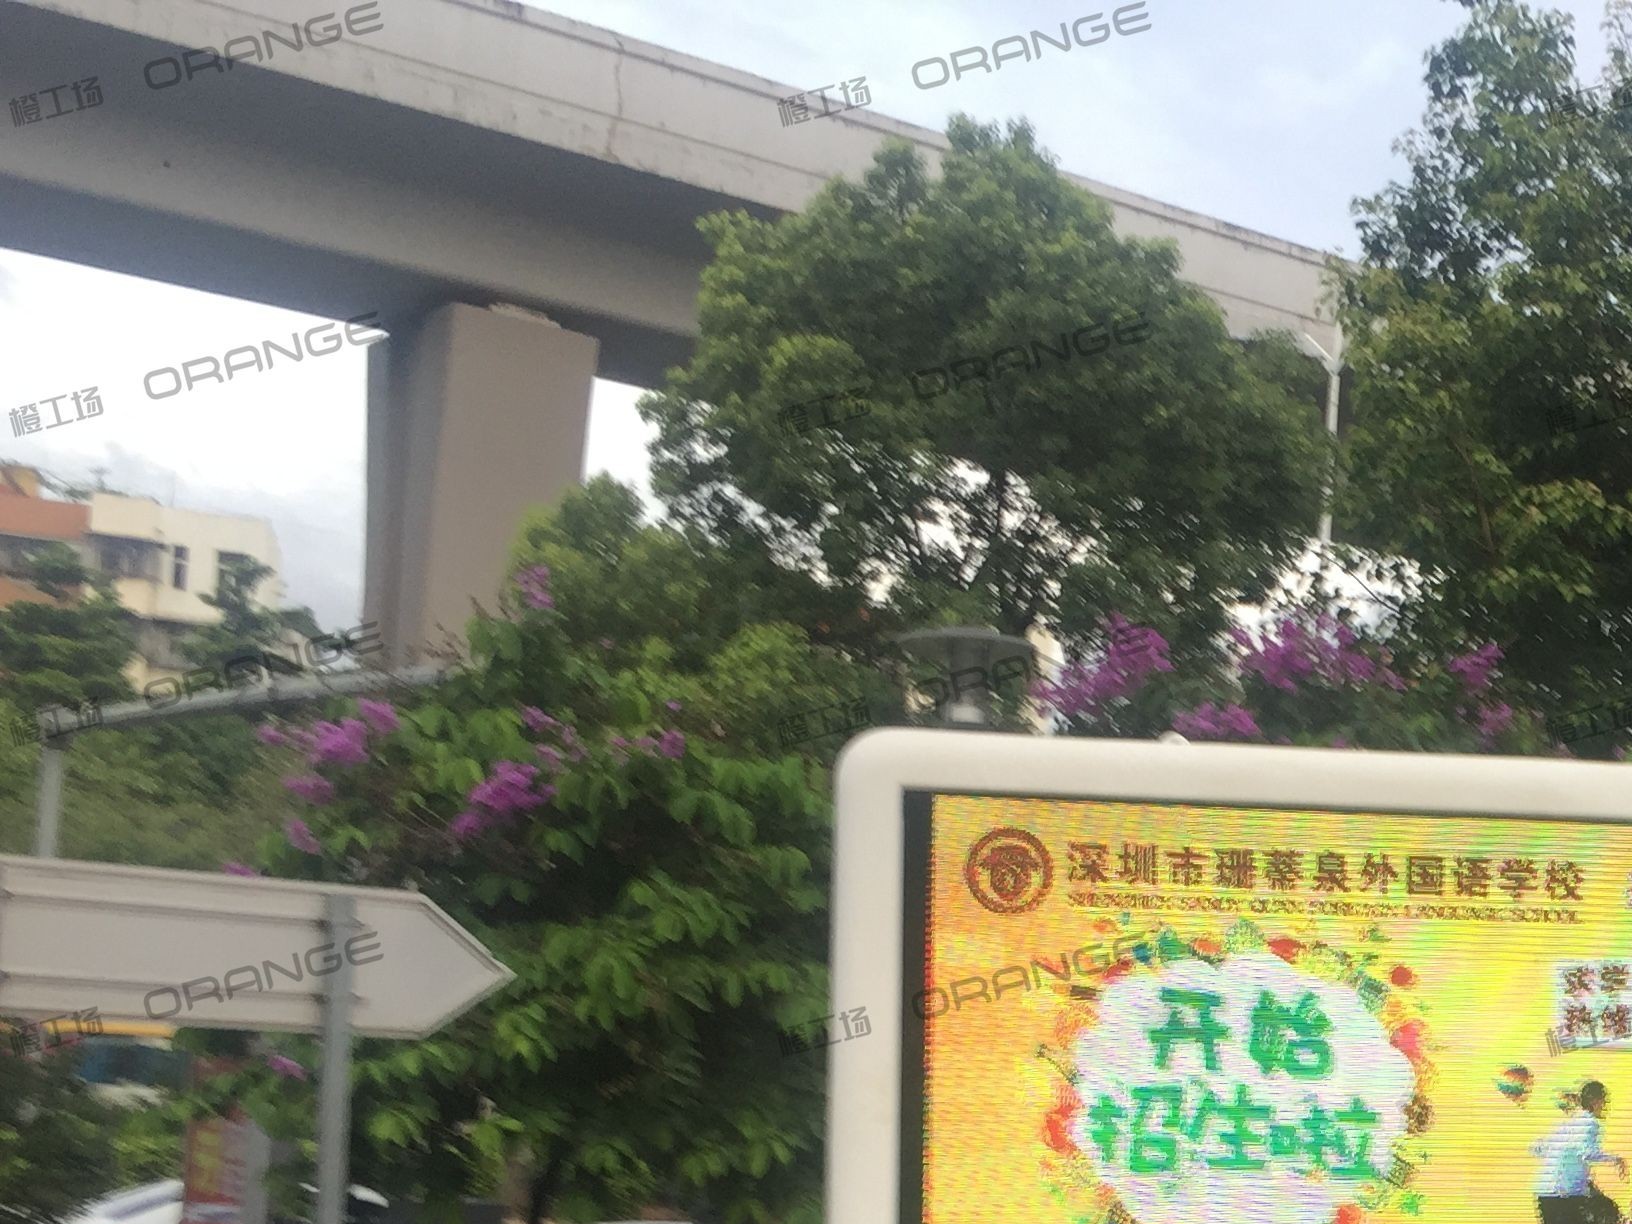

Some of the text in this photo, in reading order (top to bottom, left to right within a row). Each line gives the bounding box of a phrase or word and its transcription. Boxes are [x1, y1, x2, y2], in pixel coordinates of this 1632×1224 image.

[1149, 986, 1335, 1080] 开始
[1088, 1083, 1382, 1178] 招生啦
